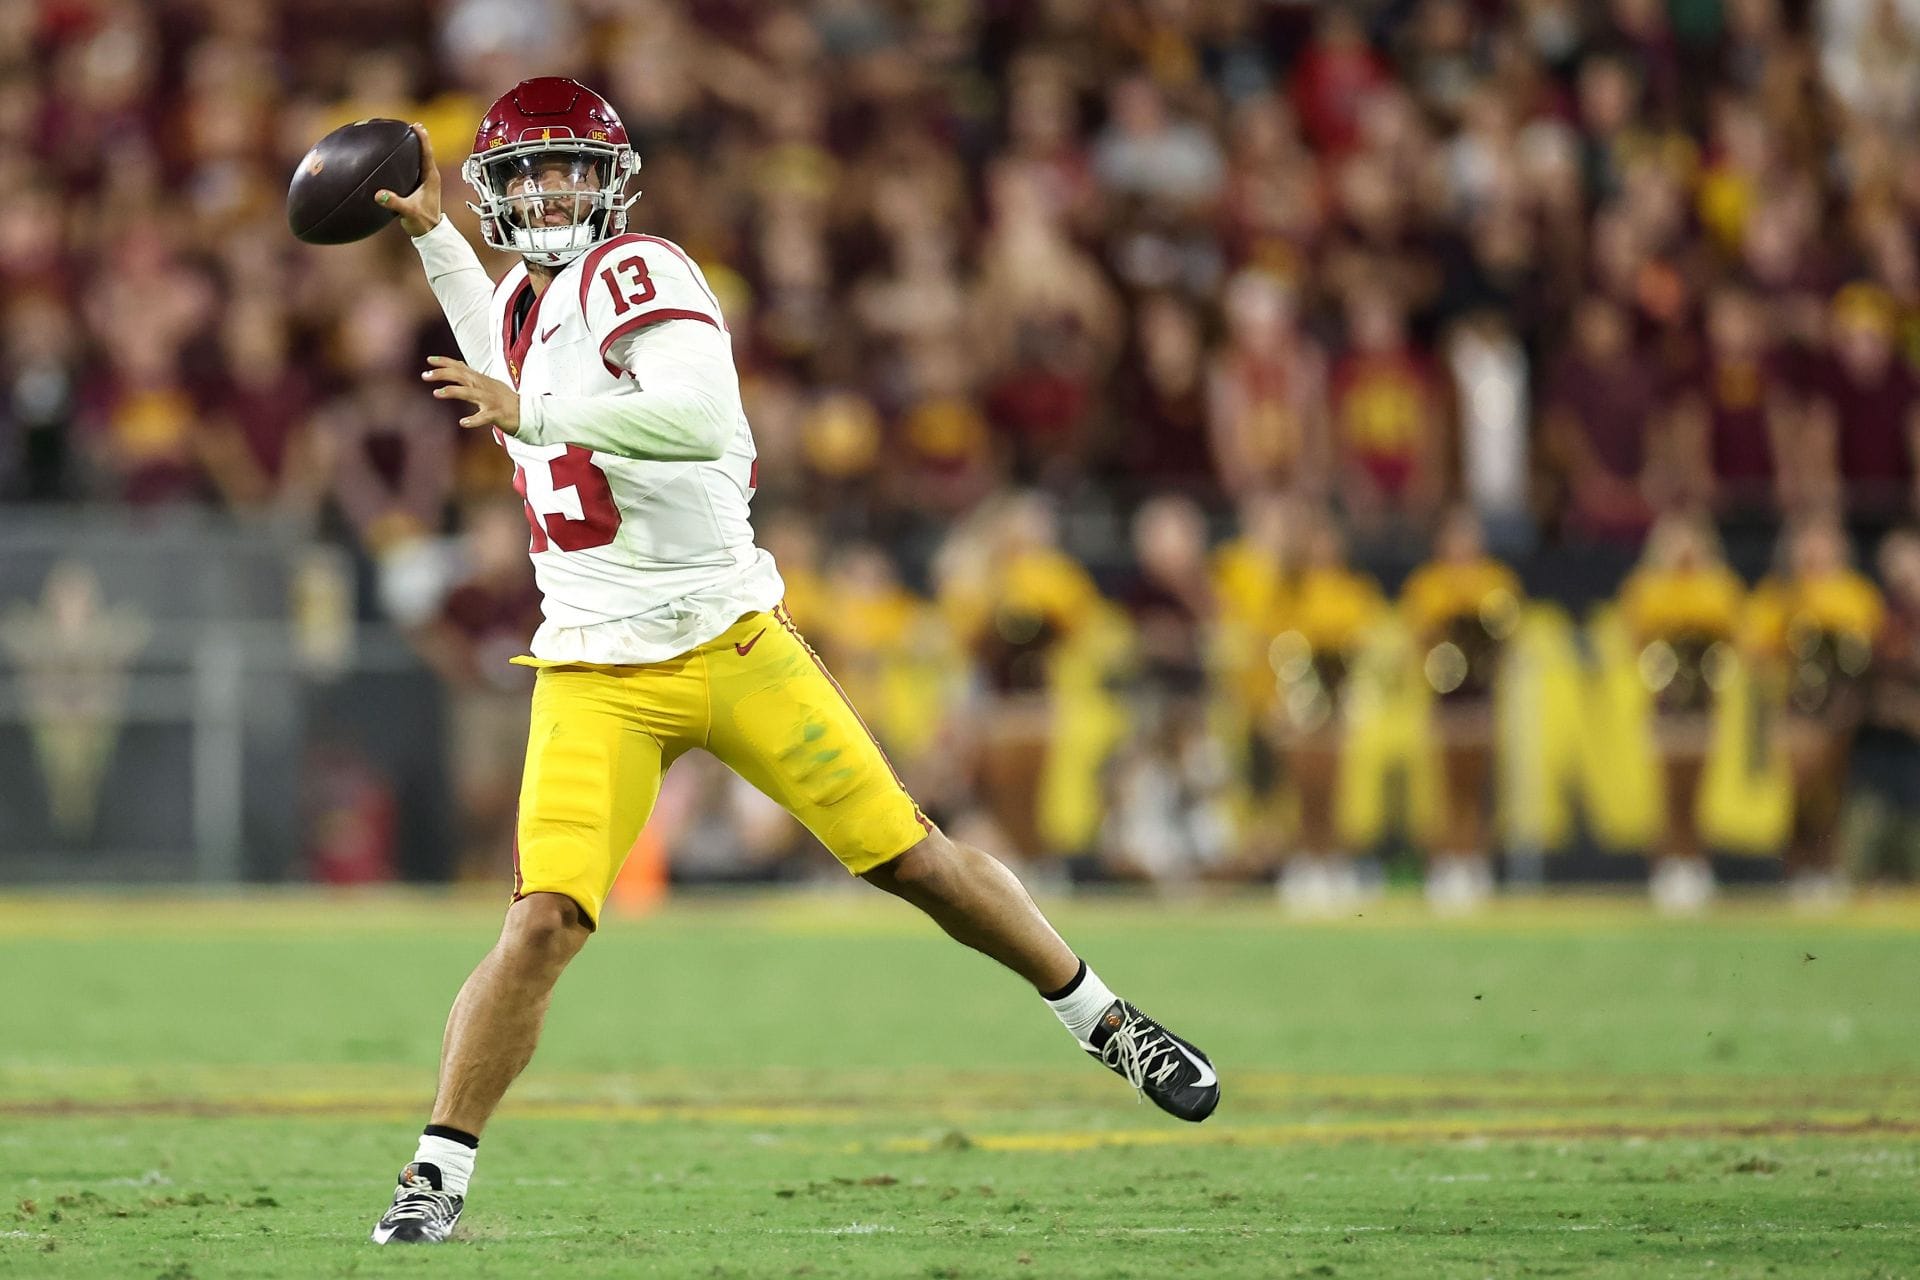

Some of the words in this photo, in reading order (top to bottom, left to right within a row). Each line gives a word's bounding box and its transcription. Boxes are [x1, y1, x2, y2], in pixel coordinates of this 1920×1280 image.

[592, 131, 607, 141] USC
[489, 137, 504, 149] USC
[600, 255, 656, 316] 13
